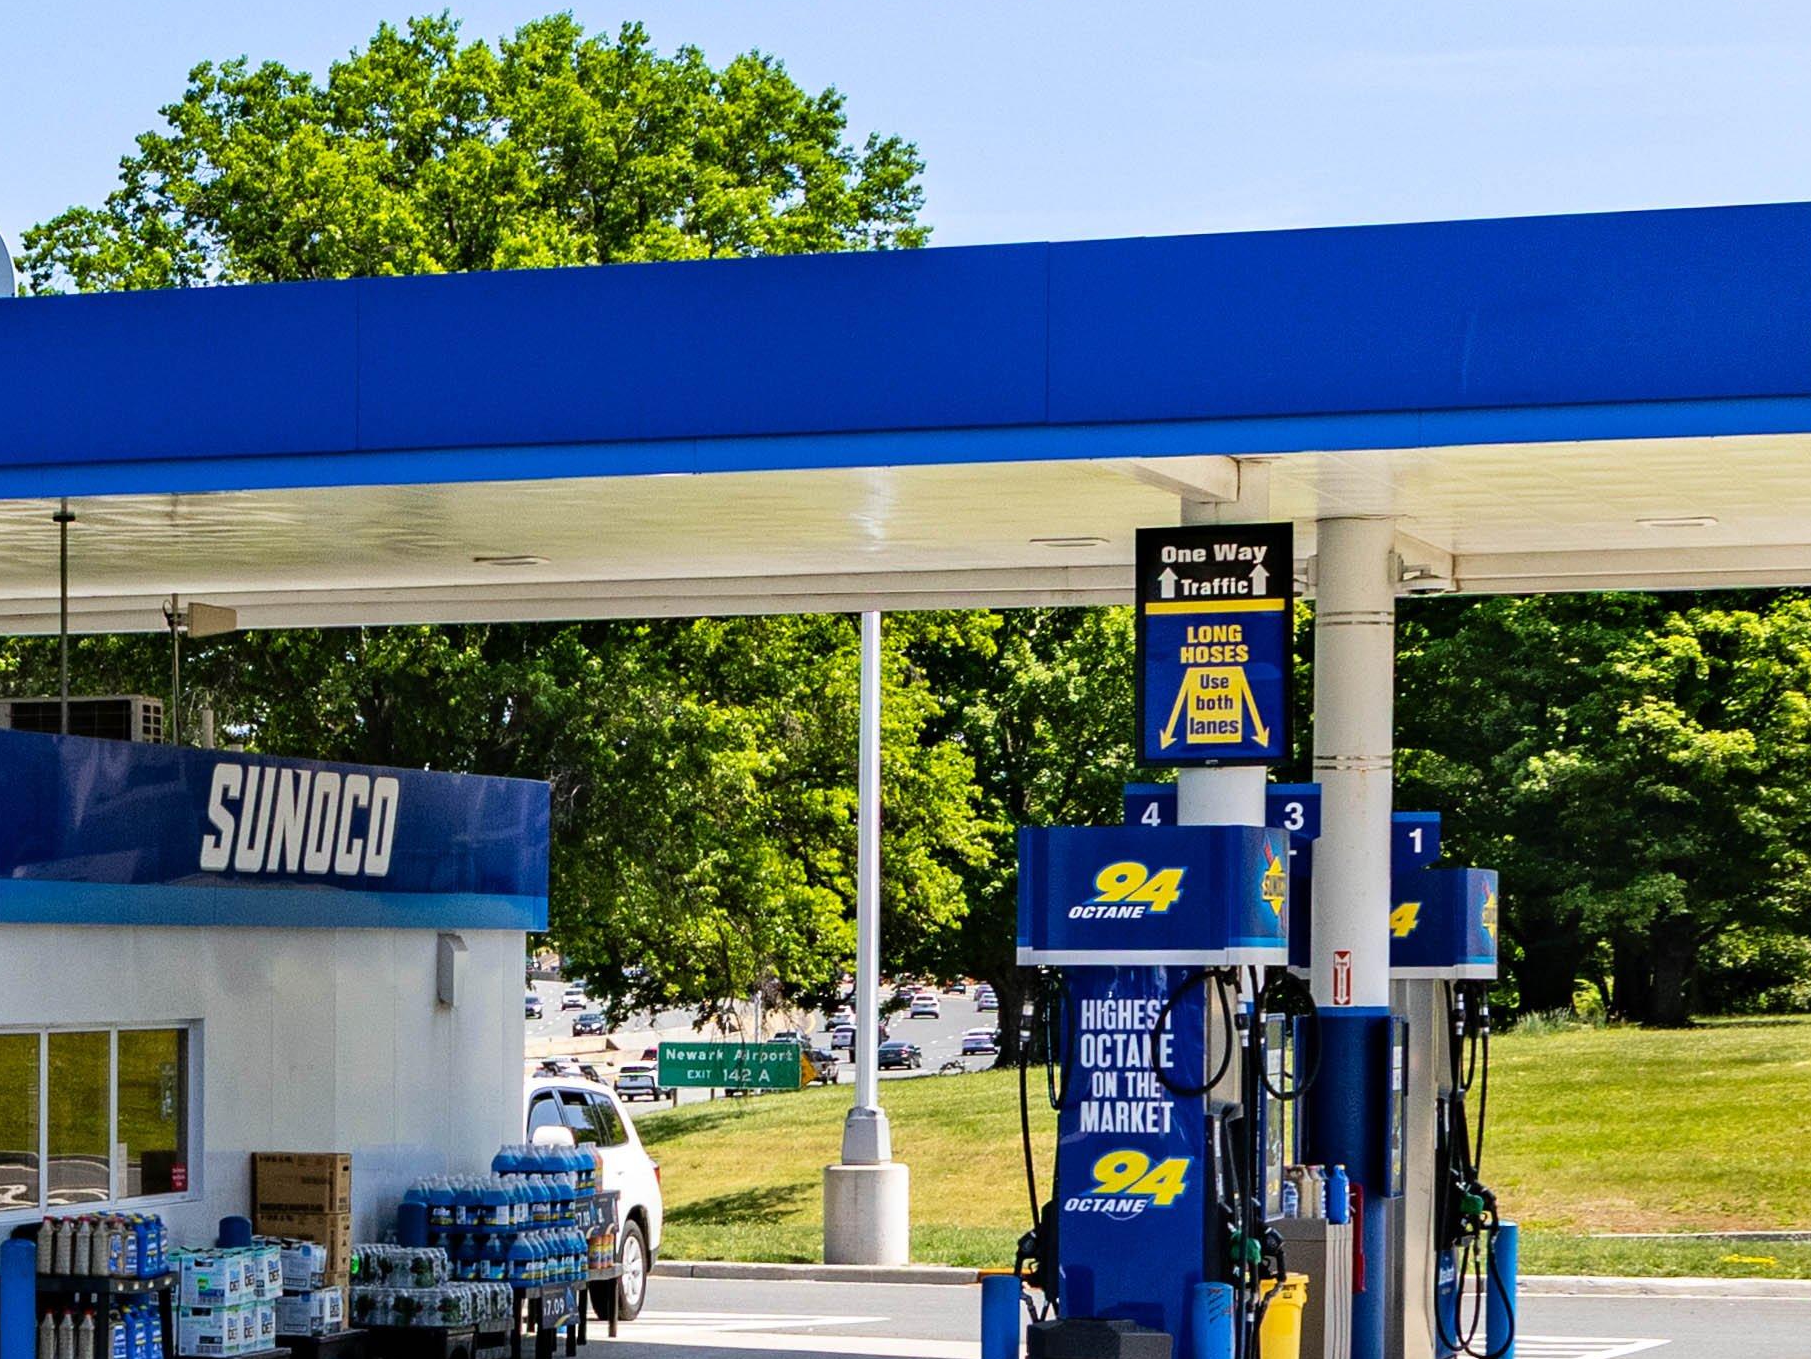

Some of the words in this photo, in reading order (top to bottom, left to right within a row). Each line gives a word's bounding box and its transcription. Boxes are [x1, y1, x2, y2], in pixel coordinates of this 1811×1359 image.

[1161, 545, 1207, 564] One
[1213, 543, 1267, 564] Way
[1181, 578, 1249, 596] Traffic
[1187, 624, 1243, 643] LONG
[1180, 644, 1249, 664] HOSES
[1200, 674, 1229, 690] Use
[1196, 694, 1234, 711] both
[1189, 717, 1239, 735] lanes
[200, 763, 399, 877] SUNOCO
[1141, 802, 1161, 826] 4
[1284, 802, 1304, 830] 3
[1408, 828, 1423, 853] 1
[1095, 861, 1184, 914] 94
[1069, 905, 1145, 919] OCTANE
[666, 1048, 724, 1061] Newark
[733, 1049, 793, 1063] Airport
[687, 1070, 711, 1079] EXIT
[723, 1069, 752, 1082] 142
[758, 1070, 770, 1082] A
[1092, 1072, 1117, 1097] ON
[1125, 1072, 1161, 1097] THE
[1080, 1101, 1174, 1133] MARKET
[1093, 1150, 1190, 1205] 94
[1064, 1198, 1147, 1213] OCTANE
